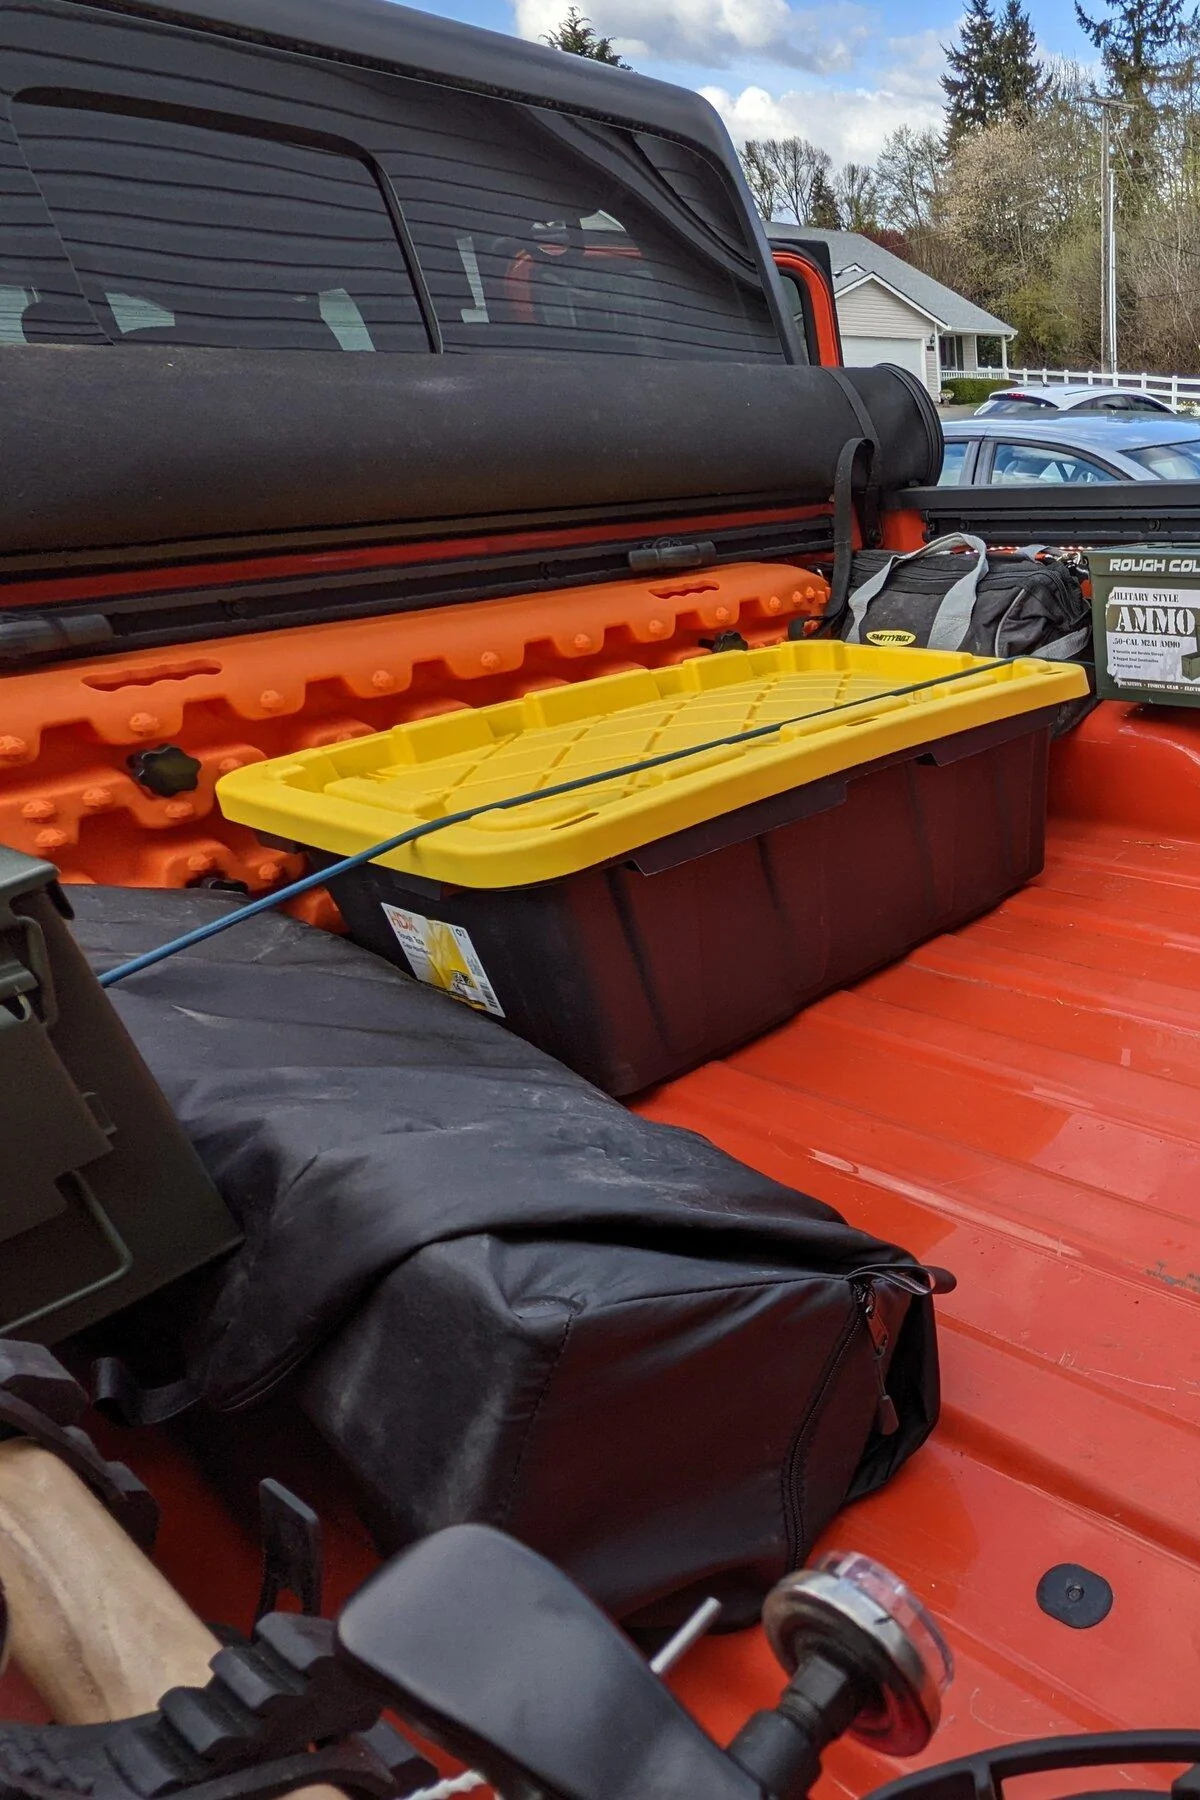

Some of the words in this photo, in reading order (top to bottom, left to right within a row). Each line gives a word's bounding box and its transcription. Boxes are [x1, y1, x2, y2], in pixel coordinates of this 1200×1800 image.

[1109, 559, 1166, 572] ROUGH
[1152, 594, 1179, 603] STYLE
[1115, 606, 1196, 635] AMMO
